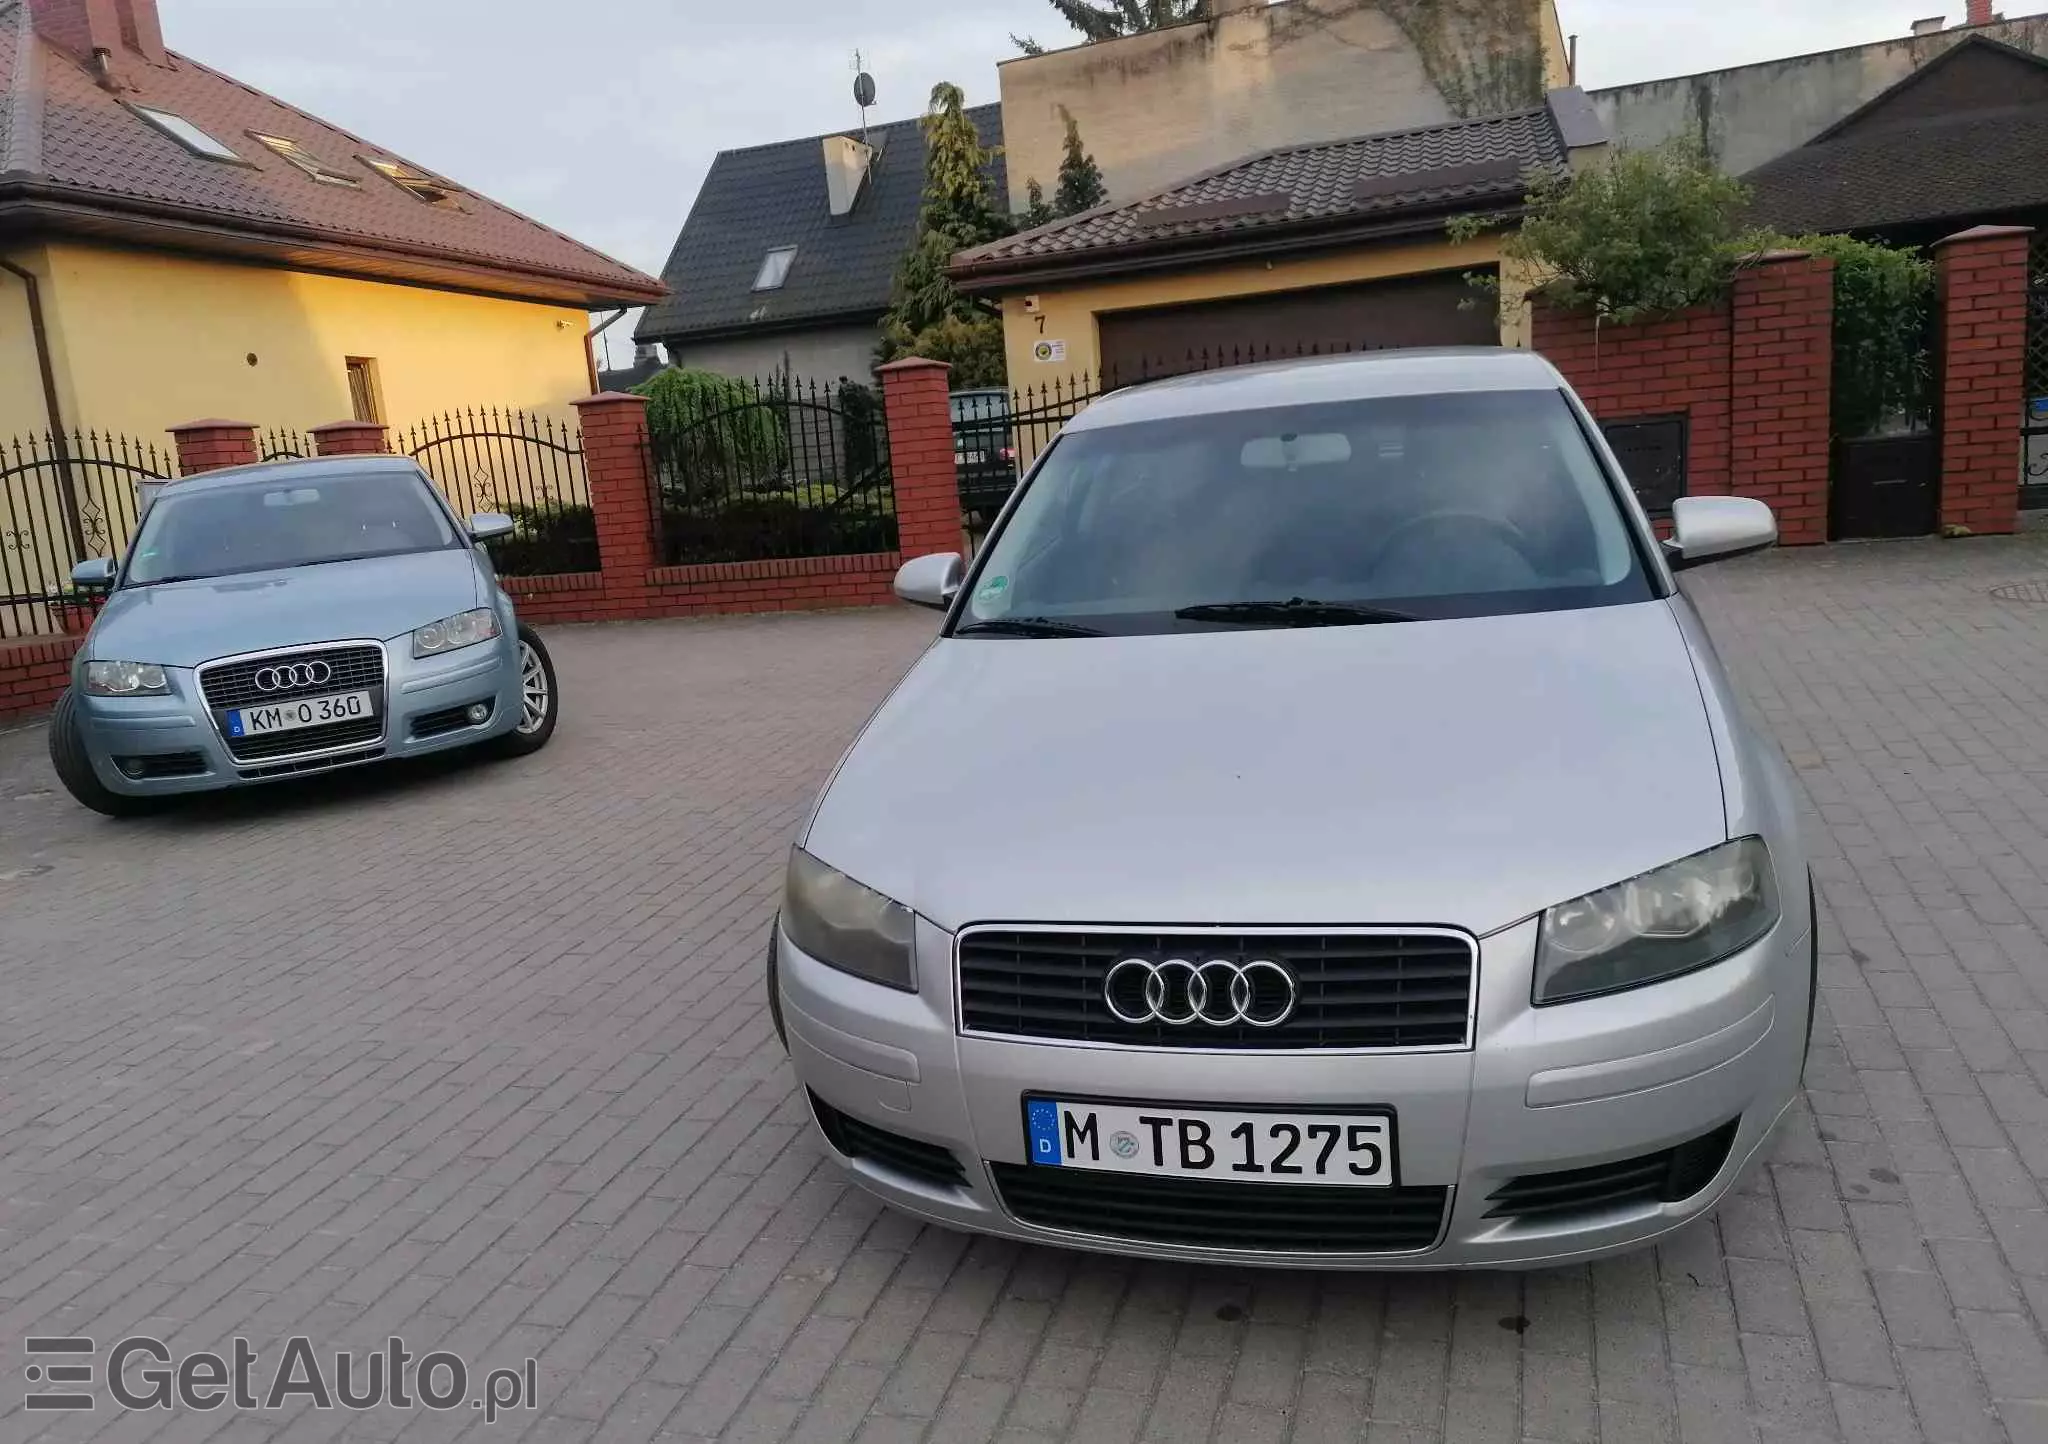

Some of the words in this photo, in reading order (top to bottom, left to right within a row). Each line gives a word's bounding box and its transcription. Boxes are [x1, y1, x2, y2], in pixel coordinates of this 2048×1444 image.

[1034, 314, 1046, 334] 7
[250, 707, 283, 731] KM
[317, 695, 361, 720] 360
[1038, 1138, 1052, 1154] D
[1063, 1110, 1100, 1161] M
[1139, 1115, 1216, 1170] TB
[1230, 1121, 1382, 1176] 1275
